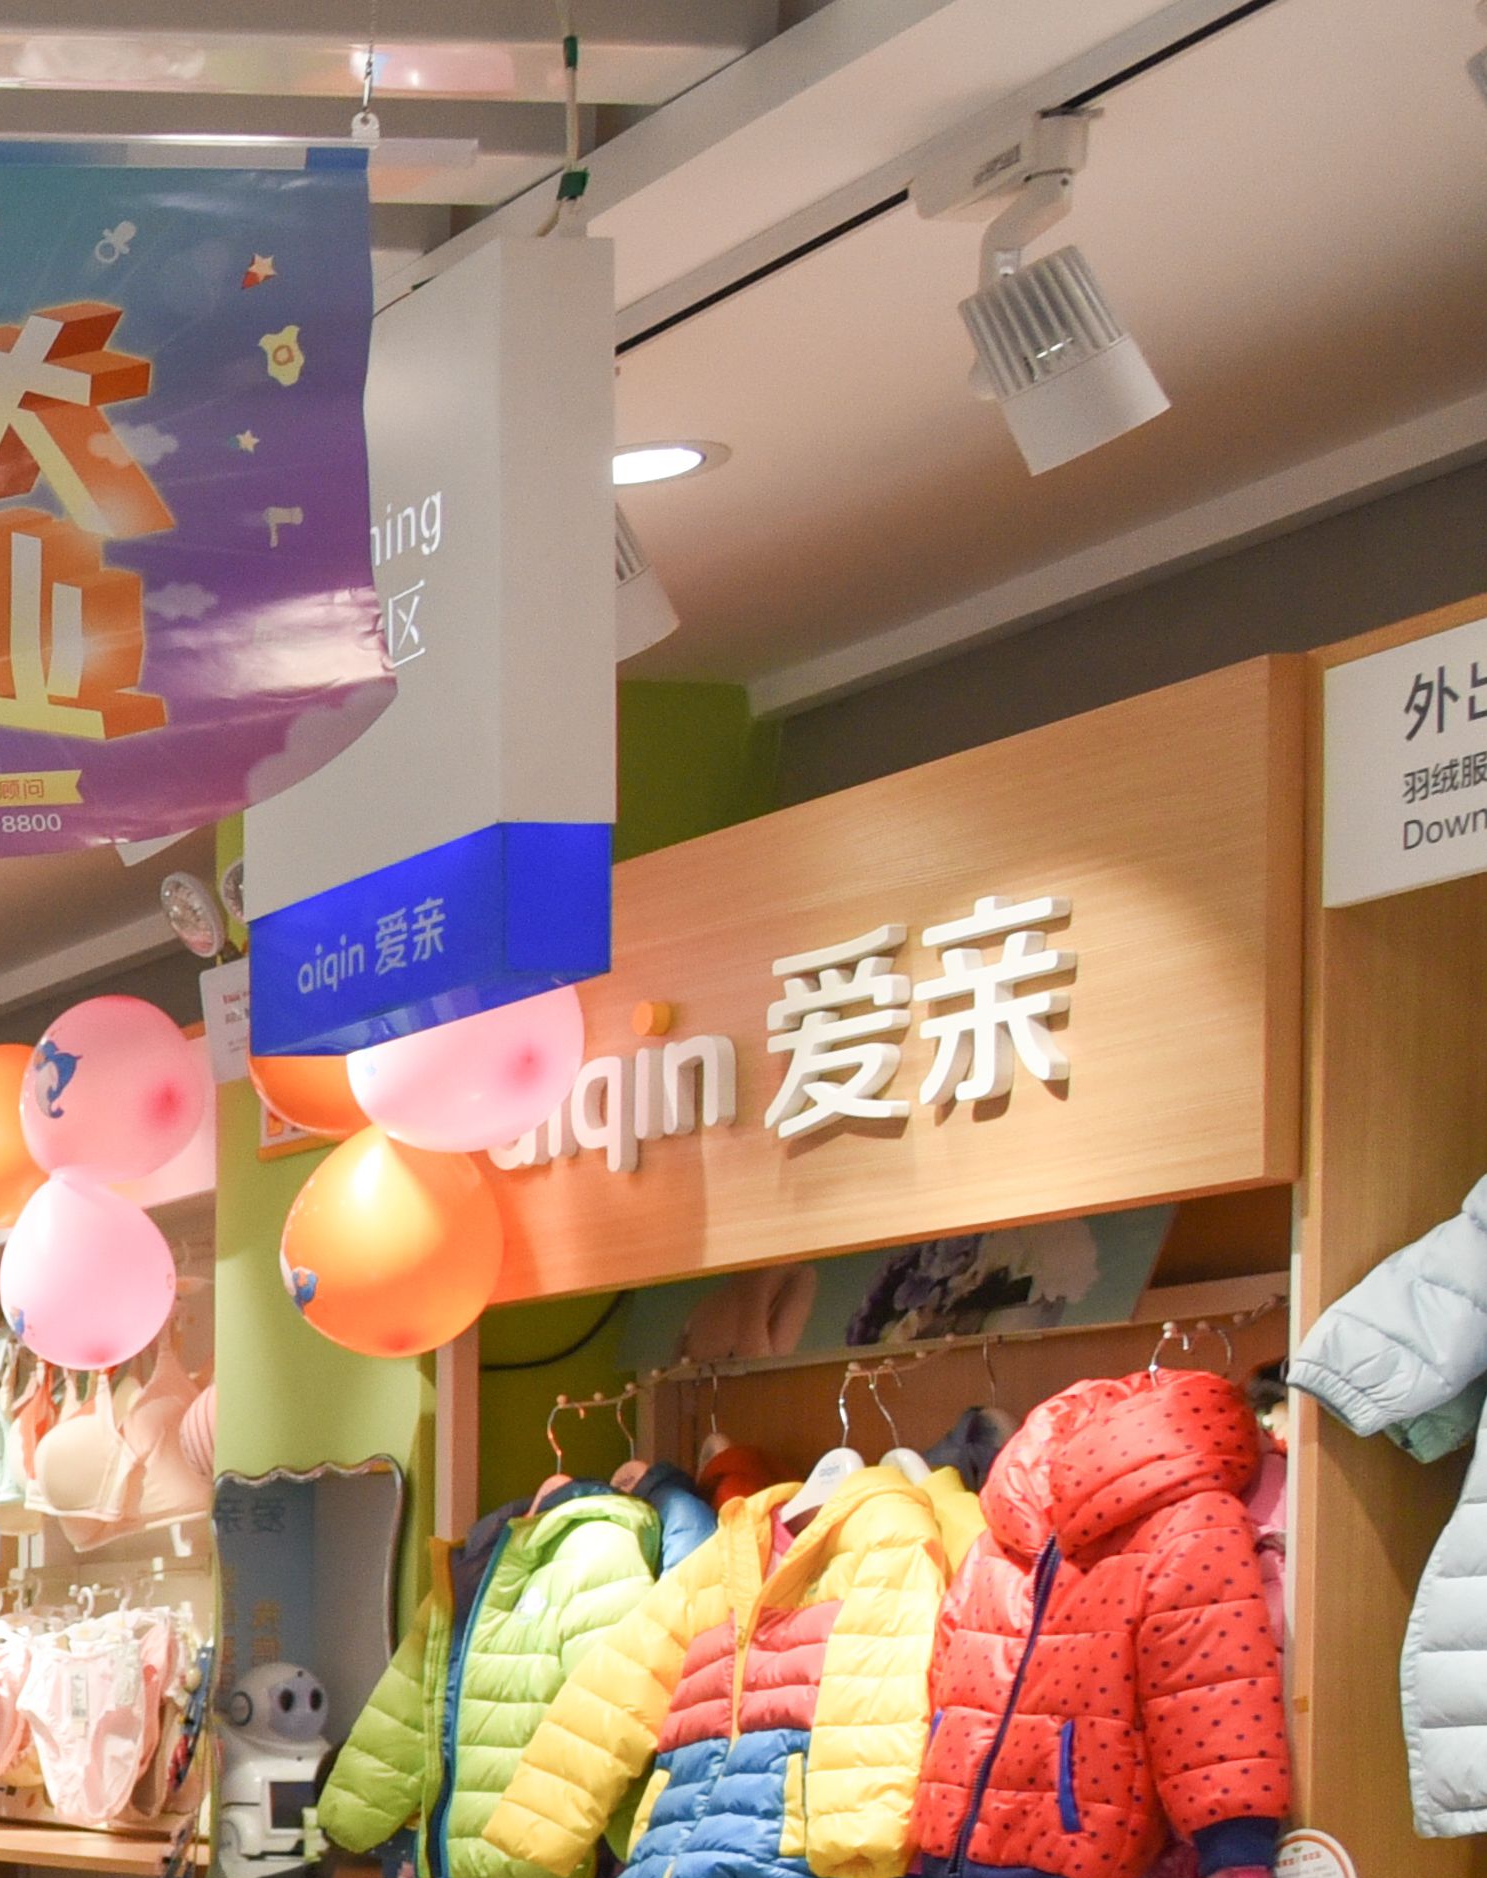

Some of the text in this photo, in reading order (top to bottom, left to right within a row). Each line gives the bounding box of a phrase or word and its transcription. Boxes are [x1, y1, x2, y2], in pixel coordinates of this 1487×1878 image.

[298, 897, 446, 993] aiqin 爱亲
[763, 894, 1077, 1140] 爱亲
